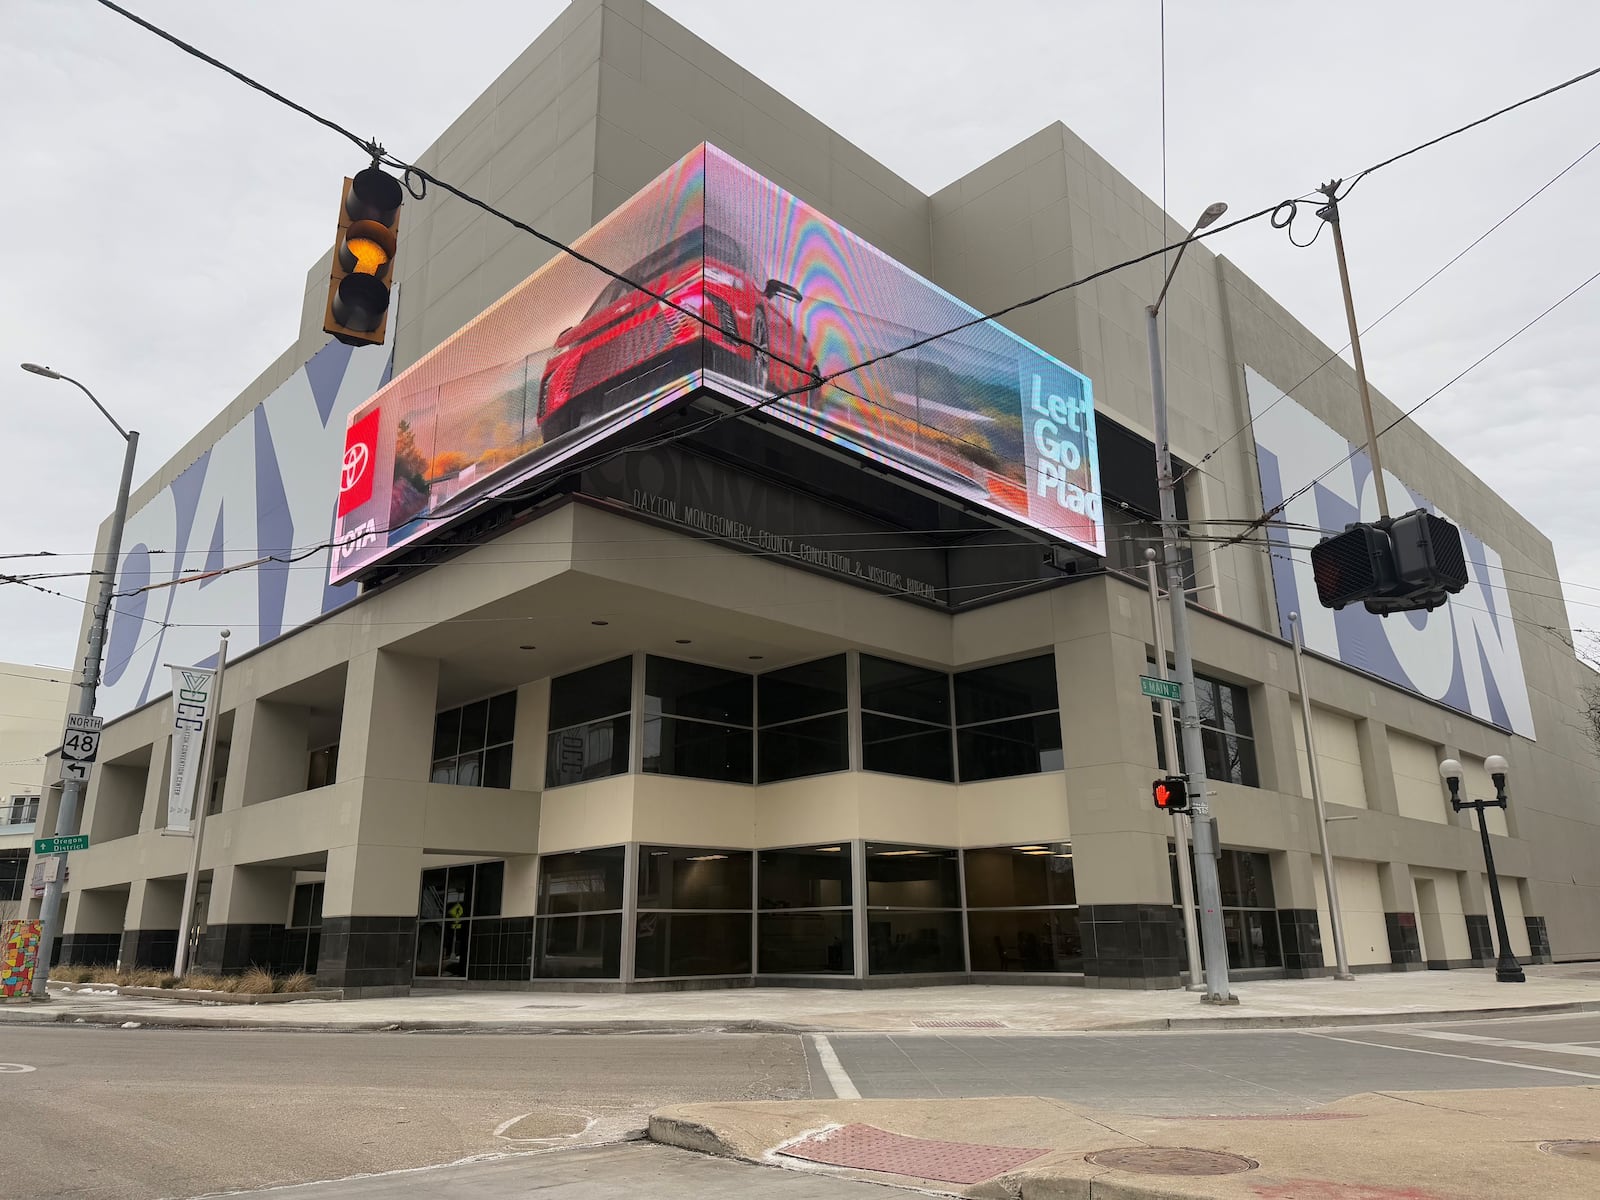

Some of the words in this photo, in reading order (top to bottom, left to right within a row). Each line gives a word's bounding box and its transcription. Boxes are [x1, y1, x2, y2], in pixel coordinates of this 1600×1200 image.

[1034, 418, 1081, 470] Go
[633, 489, 677, 521] DAYTON
[684, 506, 752, 542] MONTGOMERY
[758, 530, 793, 554] COUNTY
[800, 543, 851, 574] CONVENTION
[855, 561, 863, 577] &
[868, 565, 902, 590] VISITORS
[907, 578, 935, 600] BUREAU
[1142, 681, 1147, 689] S
[1149, 681, 1170, 696] MAIN
[69, 715, 101, 729] NORTH
[66, 734, 94, 752] 48
[177, 744, 189, 776] CONVENTION
[173, 776, 183, 796] CENTER
[53, 843, 84, 852] District
